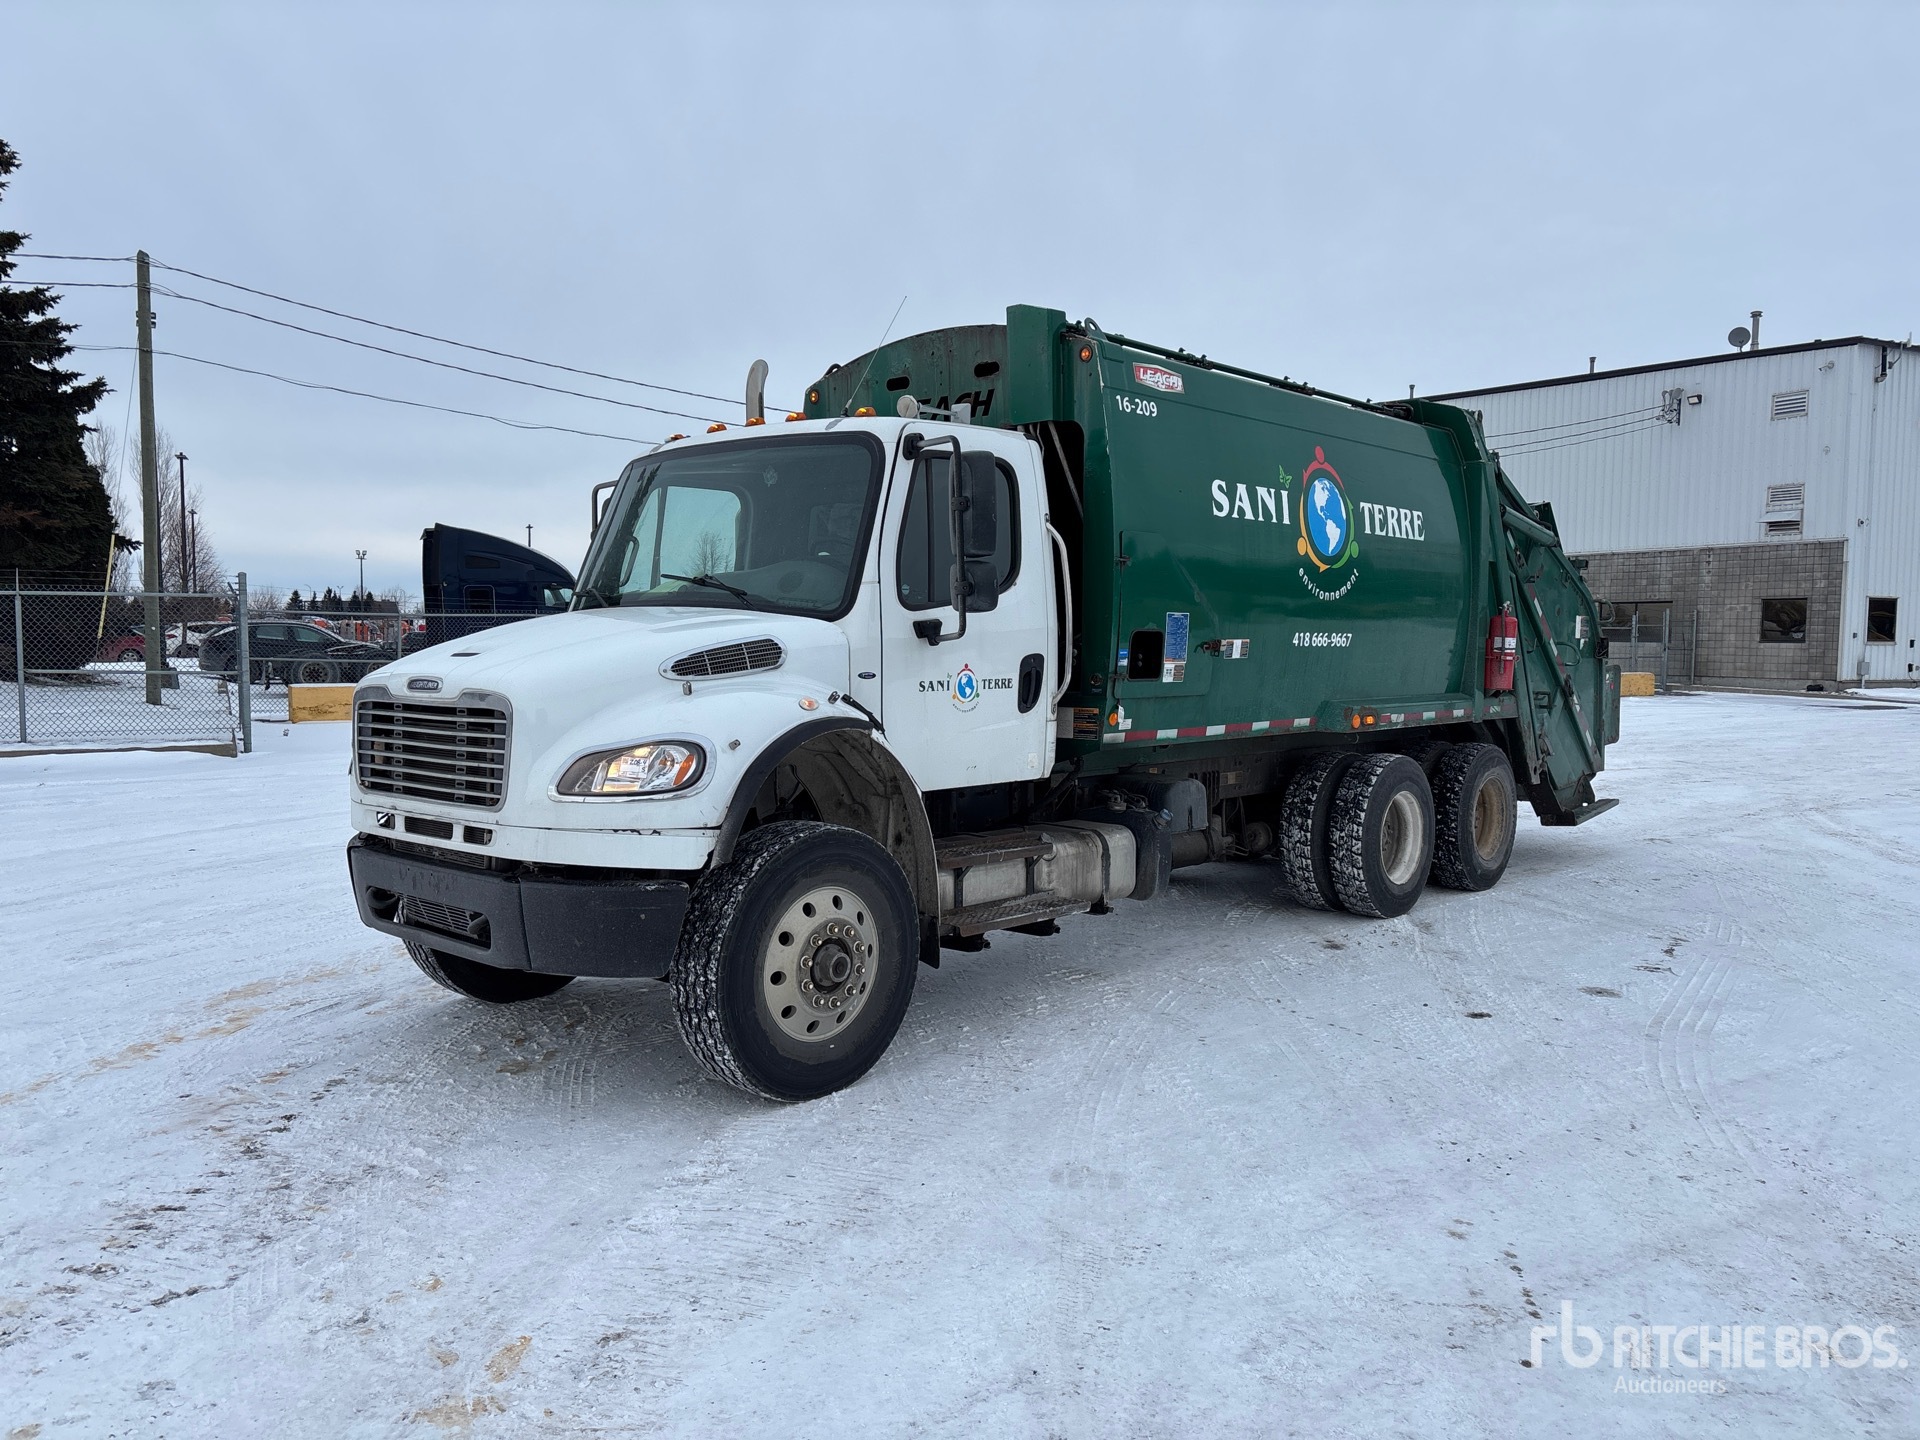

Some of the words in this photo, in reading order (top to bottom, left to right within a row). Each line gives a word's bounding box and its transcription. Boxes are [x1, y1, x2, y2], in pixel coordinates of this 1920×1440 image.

[1139, 367, 1181, 389] LEACH
[1115, 394, 1158, 417] 16-209
[1211, 478, 1291, 525] SANI
[1359, 501, 1425, 542] TERRE
[1298, 567, 1360, 601] environnement
[1292, 632, 1311, 647] 418
[1311, 632, 1353, 648] 666-9667
[918, 680, 951, 693] SANI
[981, 678, 1014, 690] TERRE
